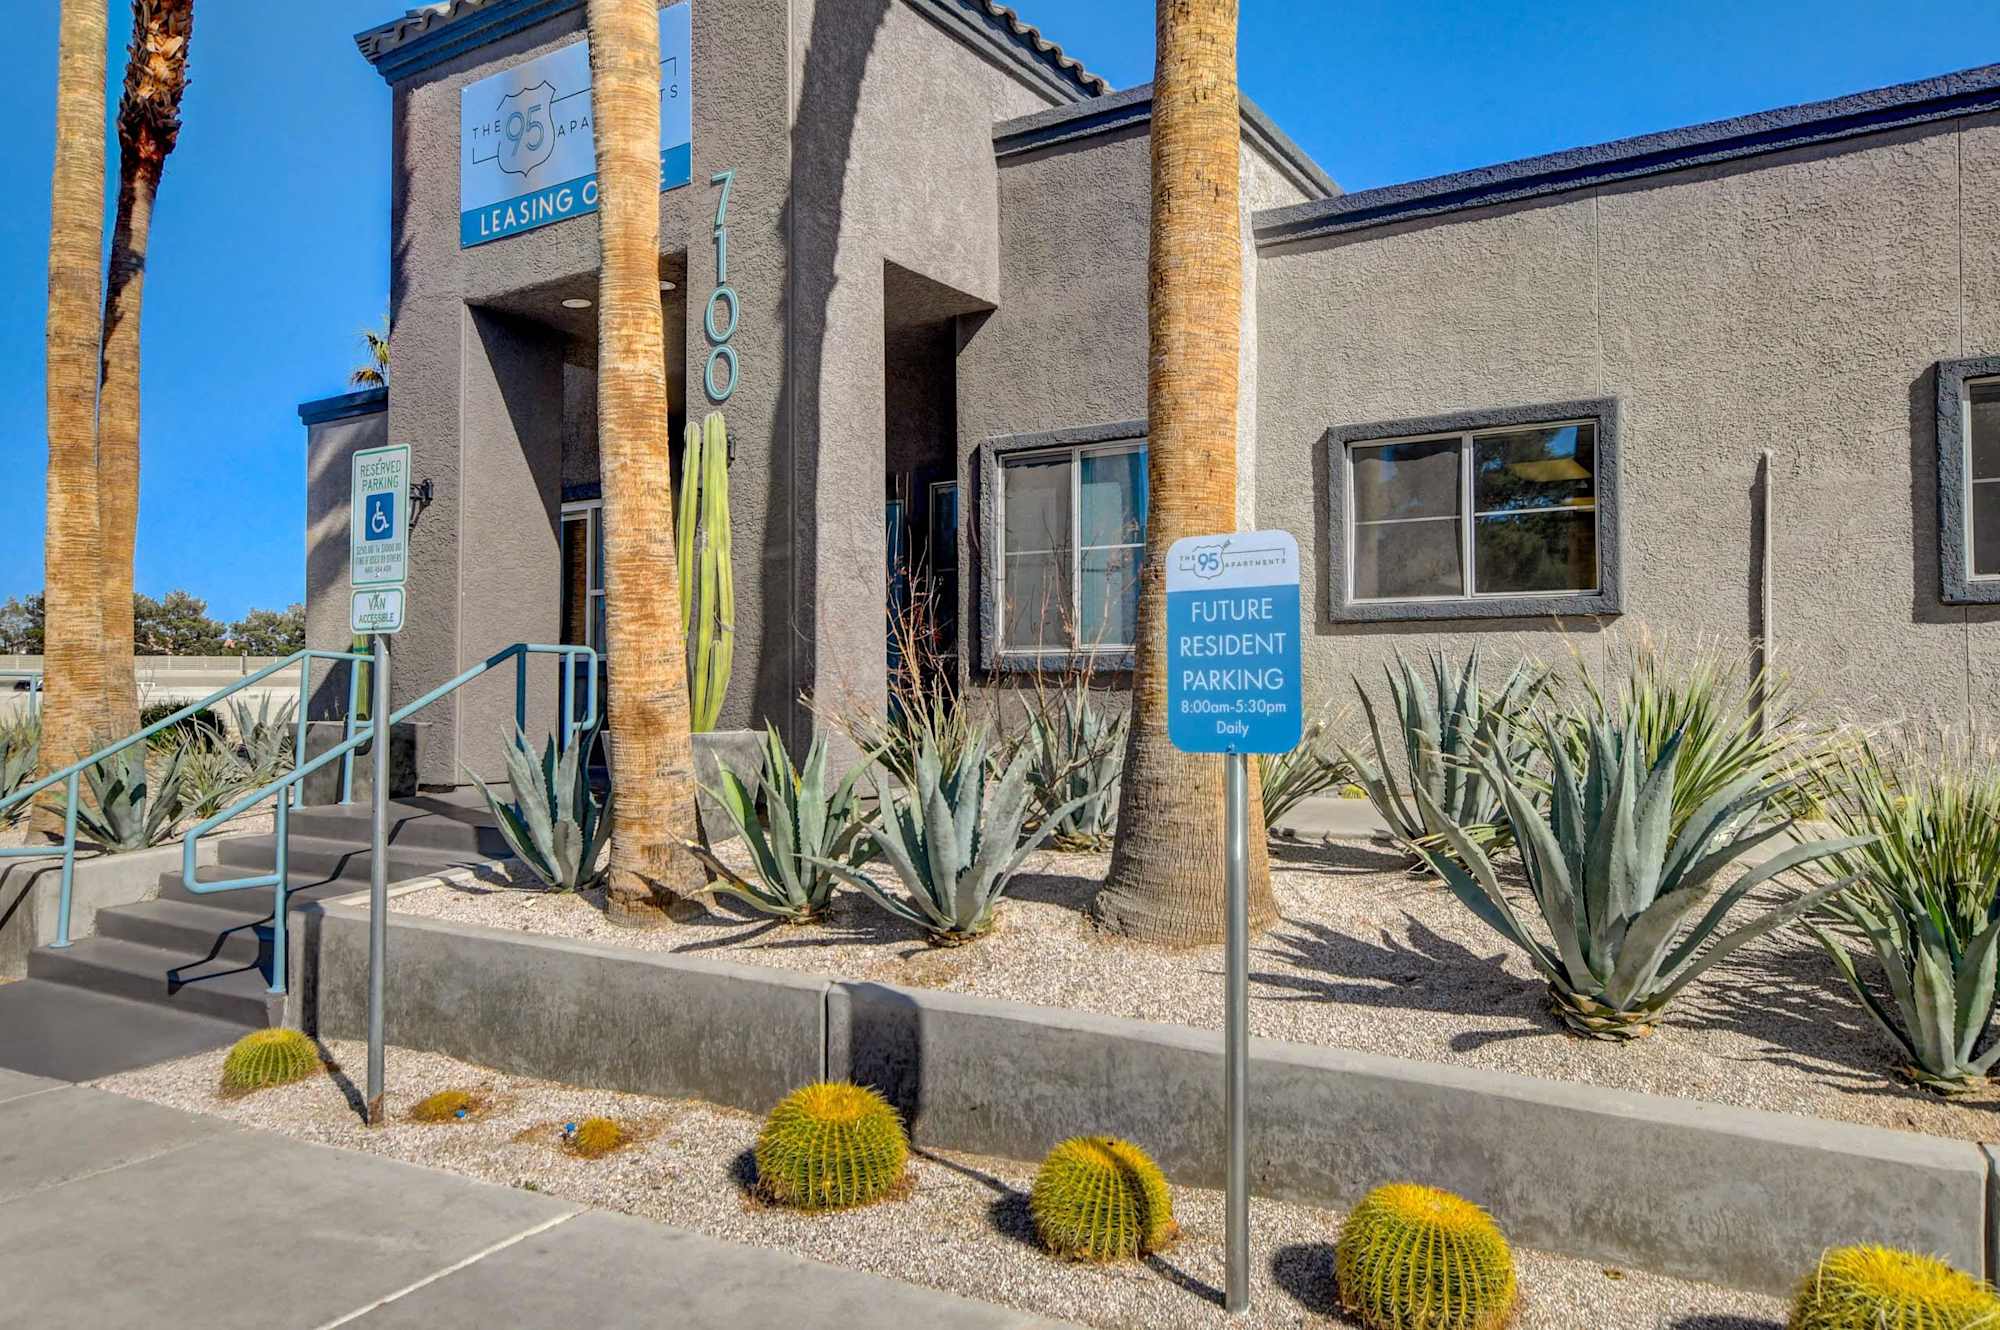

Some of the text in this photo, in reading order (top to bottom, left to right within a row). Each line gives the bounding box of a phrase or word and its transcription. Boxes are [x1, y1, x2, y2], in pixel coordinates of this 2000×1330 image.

[472, 120, 501, 140] THE
[506, 104, 544, 156] 95
[480, 188, 574, 236] LEASING
[704, 168, 739, 402] 7100
[360, 460, 401, 477] RESERVED
[362, 475, 399, 491] PARKING
[1198, 552, 1219, 571] 95
[1225, 558, 1287, 568] APARTMENTS
[368, 597, 386, 610] VAN
[1191, 598, 1273, 623] FUTURE
[358, 612, 395, 624] ACCESSIBLE
[1180, 632, 1287, 657] RESIDENT
[1183, 668, 1284, 691] PARKING
[1181, 700, 1286, 715] 8:00am-5:30pm
[1216, 721, 1249, 738] Daily
